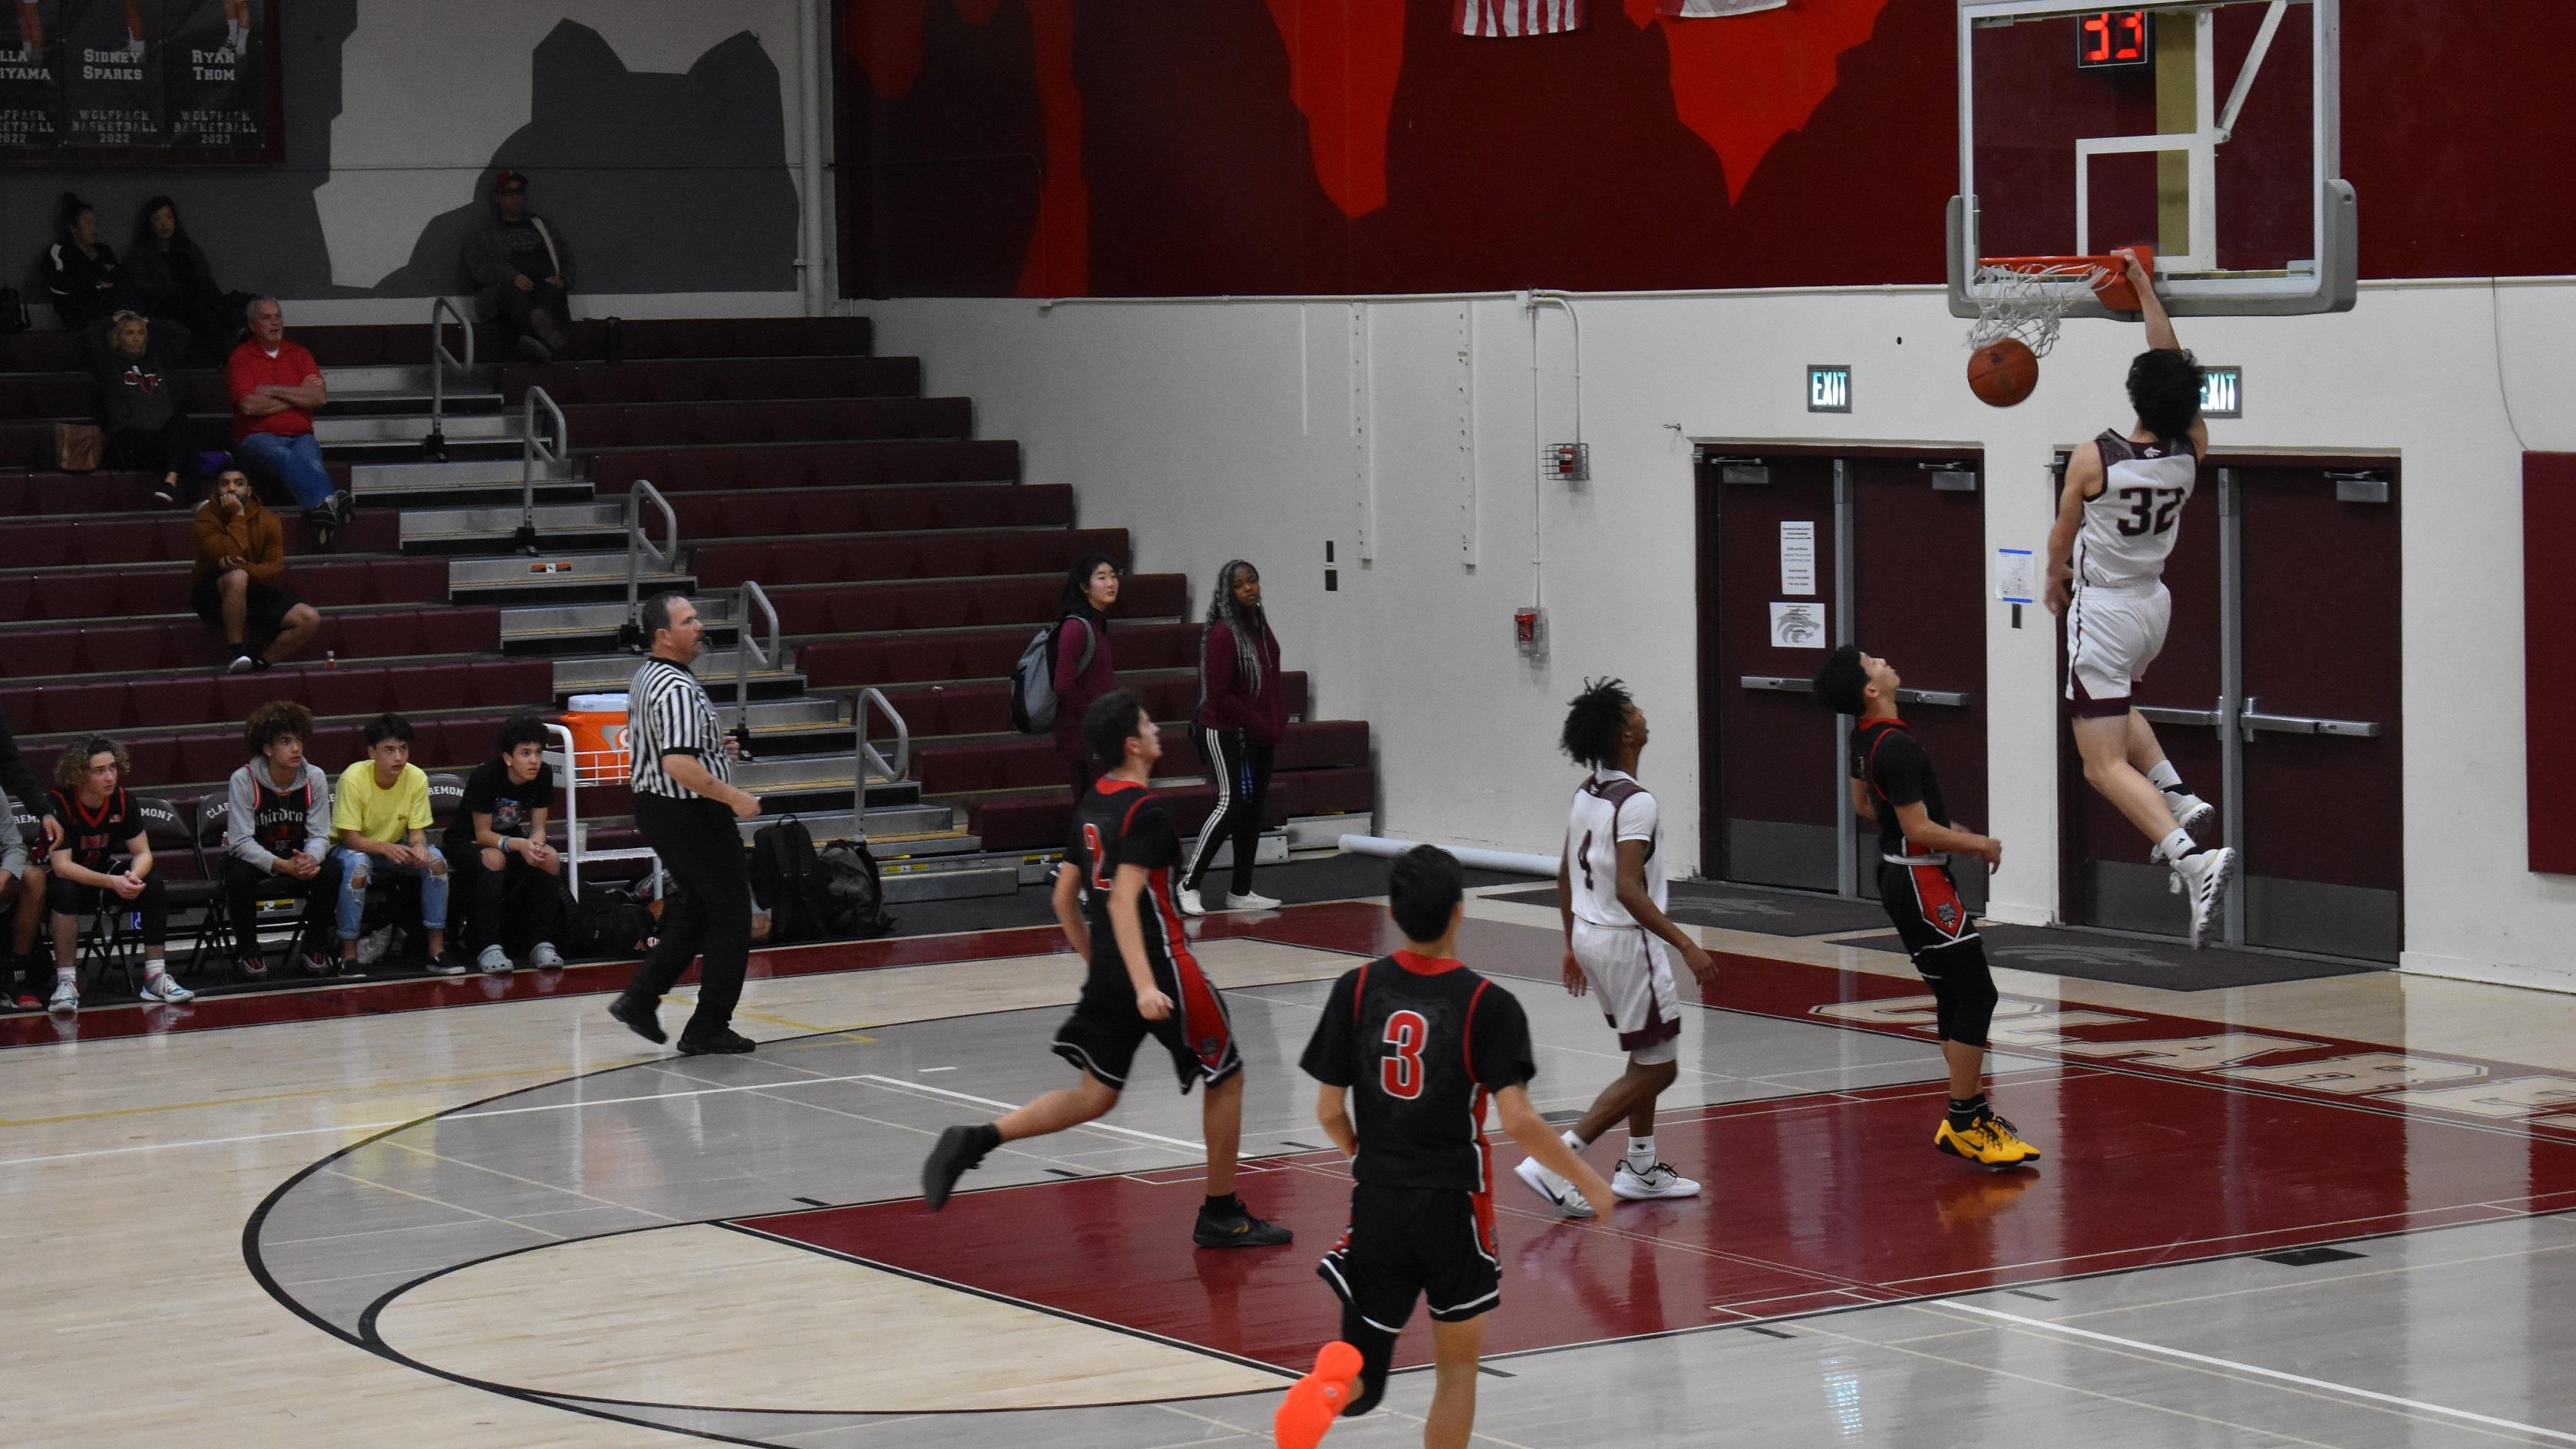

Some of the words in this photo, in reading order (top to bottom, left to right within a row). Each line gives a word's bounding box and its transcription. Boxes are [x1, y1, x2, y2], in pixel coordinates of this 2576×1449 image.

[0, 51, 28, 62] LLA
[0, 121, 54, 132] ETBALL
[99, 134, 130, 143] 2022
[1812, 371, 1848, 405] EXIT
[2116, 487, 2185, 536] 32
[12, 814, 41, 824] REM
[1082, 823, 1114, 890] 2
[1577, 829, 1594, 892] 4
[1380, 1009, 1429, 1100] 3
